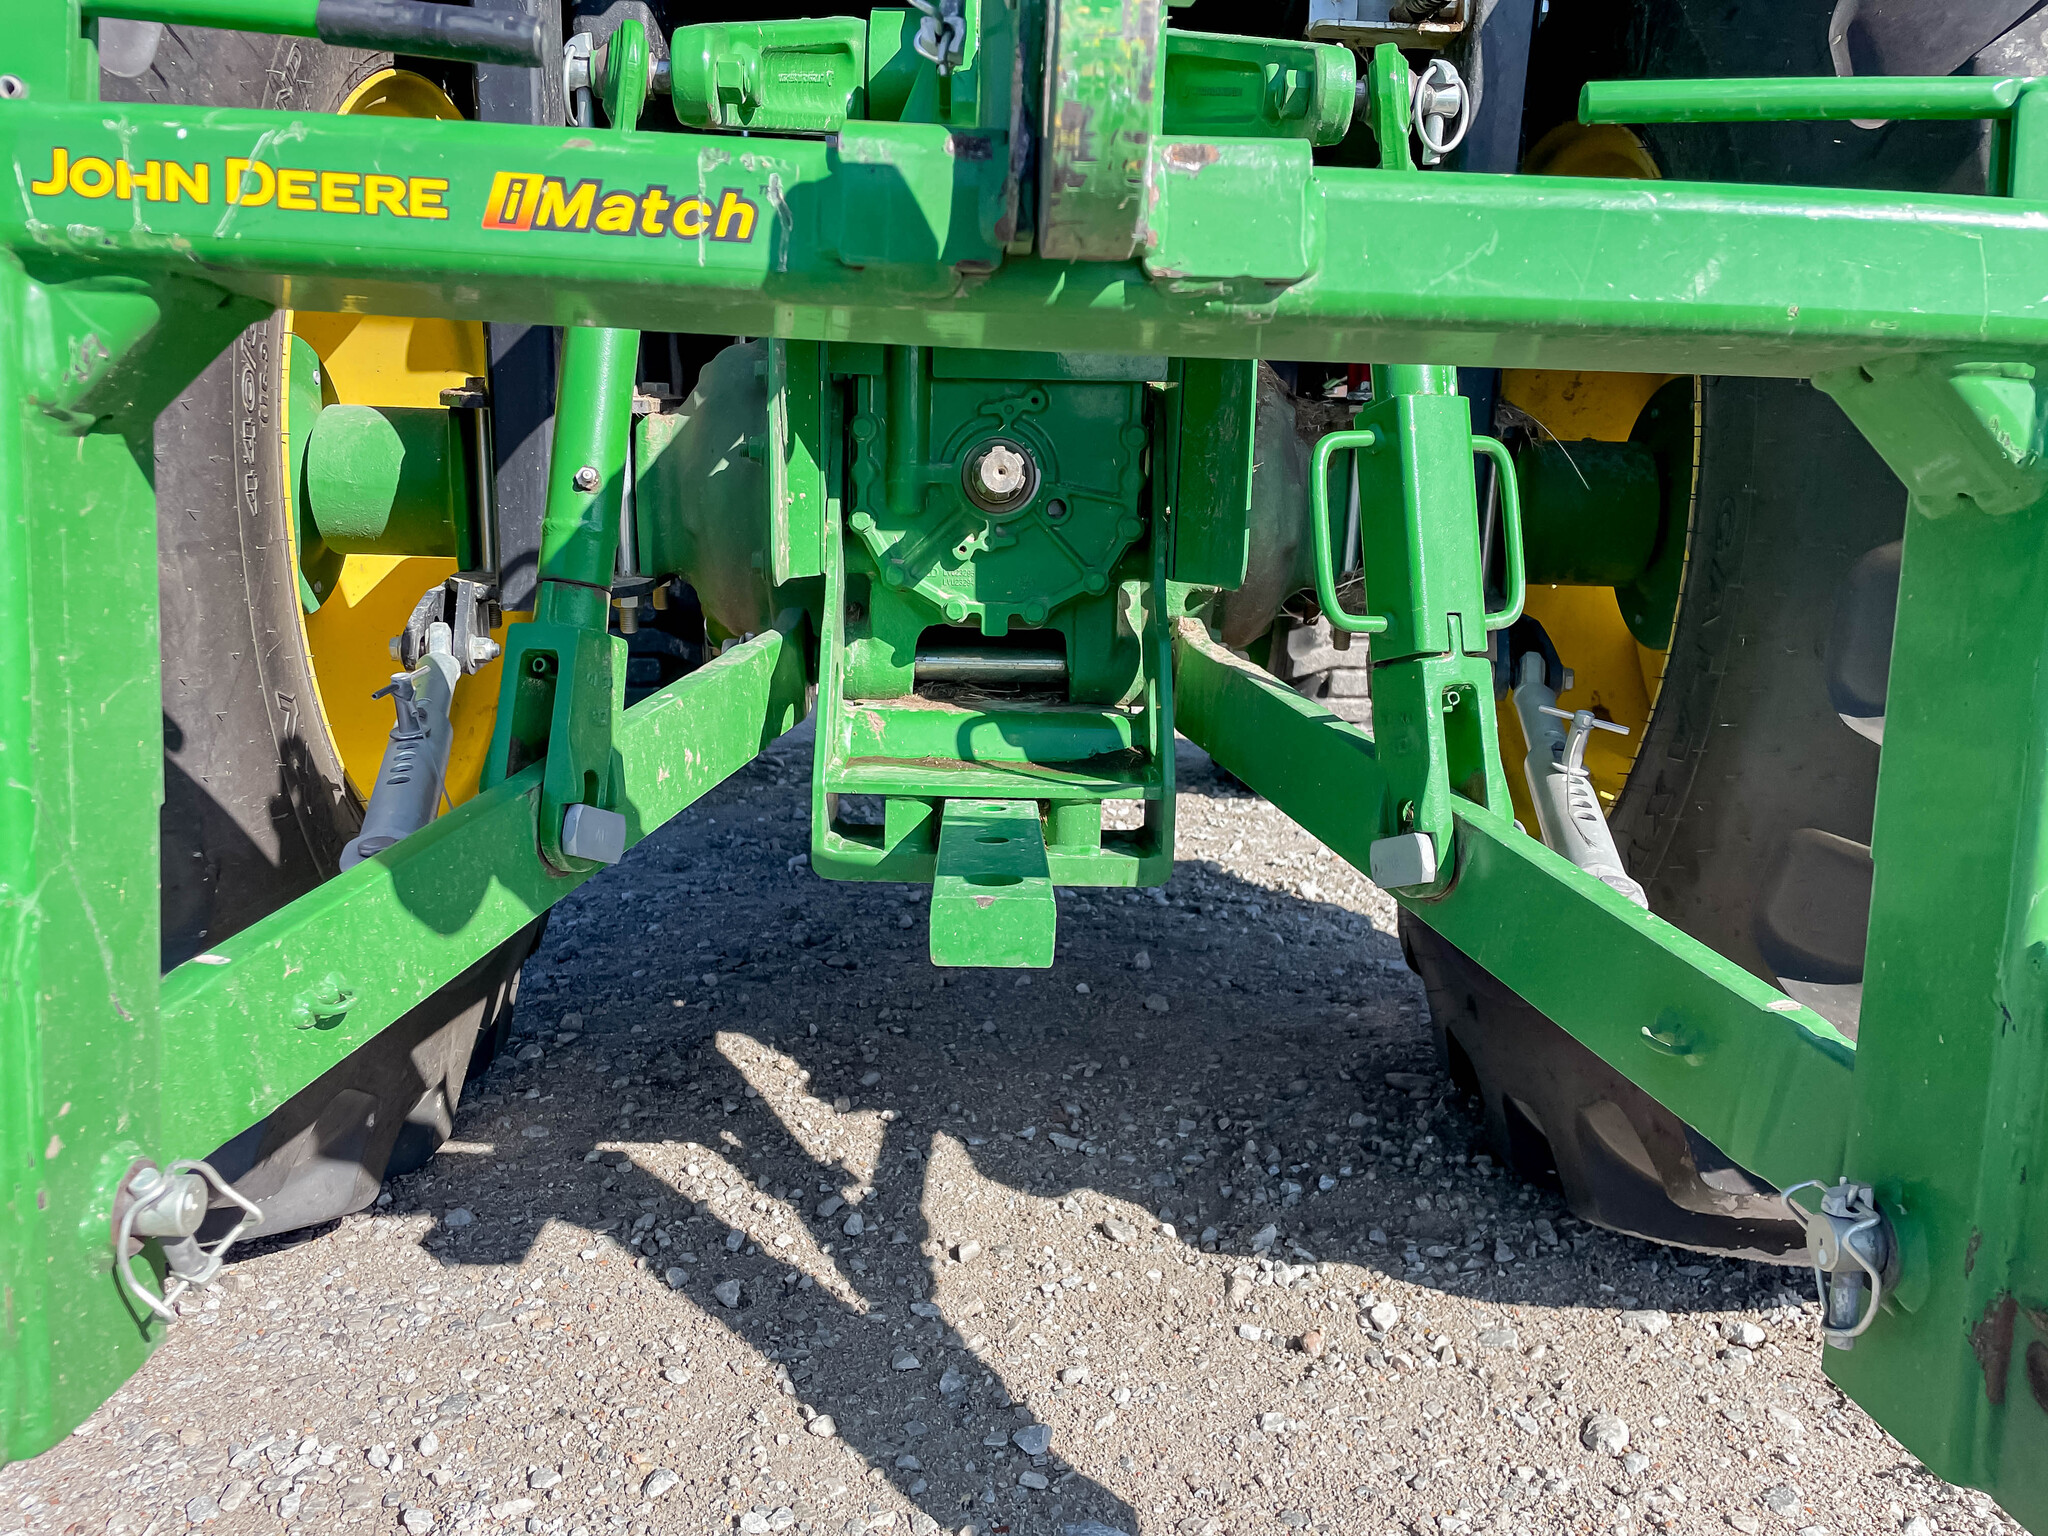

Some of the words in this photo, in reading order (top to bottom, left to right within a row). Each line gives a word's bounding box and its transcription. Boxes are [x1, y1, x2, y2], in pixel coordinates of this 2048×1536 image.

[31, 147, 210, 205] JOHN
[223, 157, 449, 219] DEERE
[484, 172, 758, 242] iMatch
